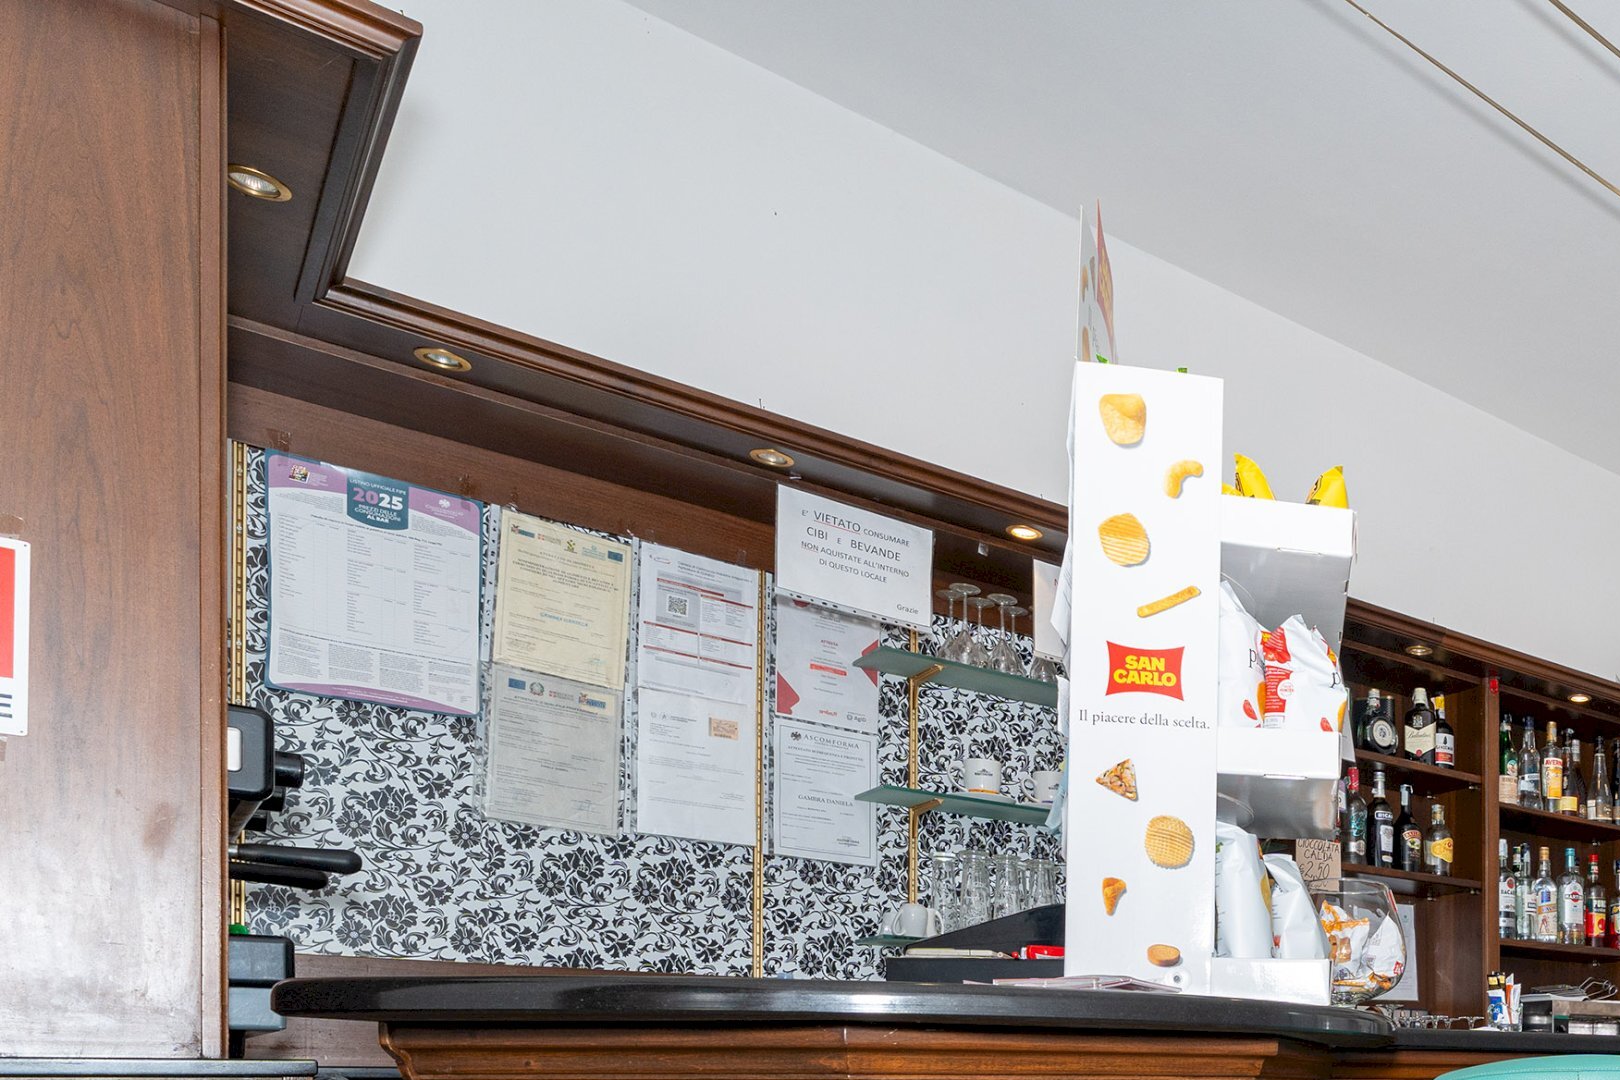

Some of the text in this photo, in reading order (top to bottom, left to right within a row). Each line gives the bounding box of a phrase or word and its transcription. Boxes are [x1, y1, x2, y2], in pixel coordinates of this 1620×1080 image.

[352, 487, 403, 510] 2025
[813, 510, 862, 534] VIETATO
[863, 528, 910, 548] CONSUMARE
[806, 526, 901, 562] CIBI E BEVANDE
[801, 541, 910, 578] NON AQUISTATE ALL'INTERNO
[819, 558, 888, 584] DI QUESTO LOCALE
[896, 603, 920, 615] Grazie
[1125, 655, 1165, 671] SAN
[1113, 669, 1177, 687] CARLO
[1079, 709, 1211, 729] Il piacere della scelta.
[1297, 839, 1340, 853] CIOCCOLATA
[1304, 849, 1333, 861] CALDA
